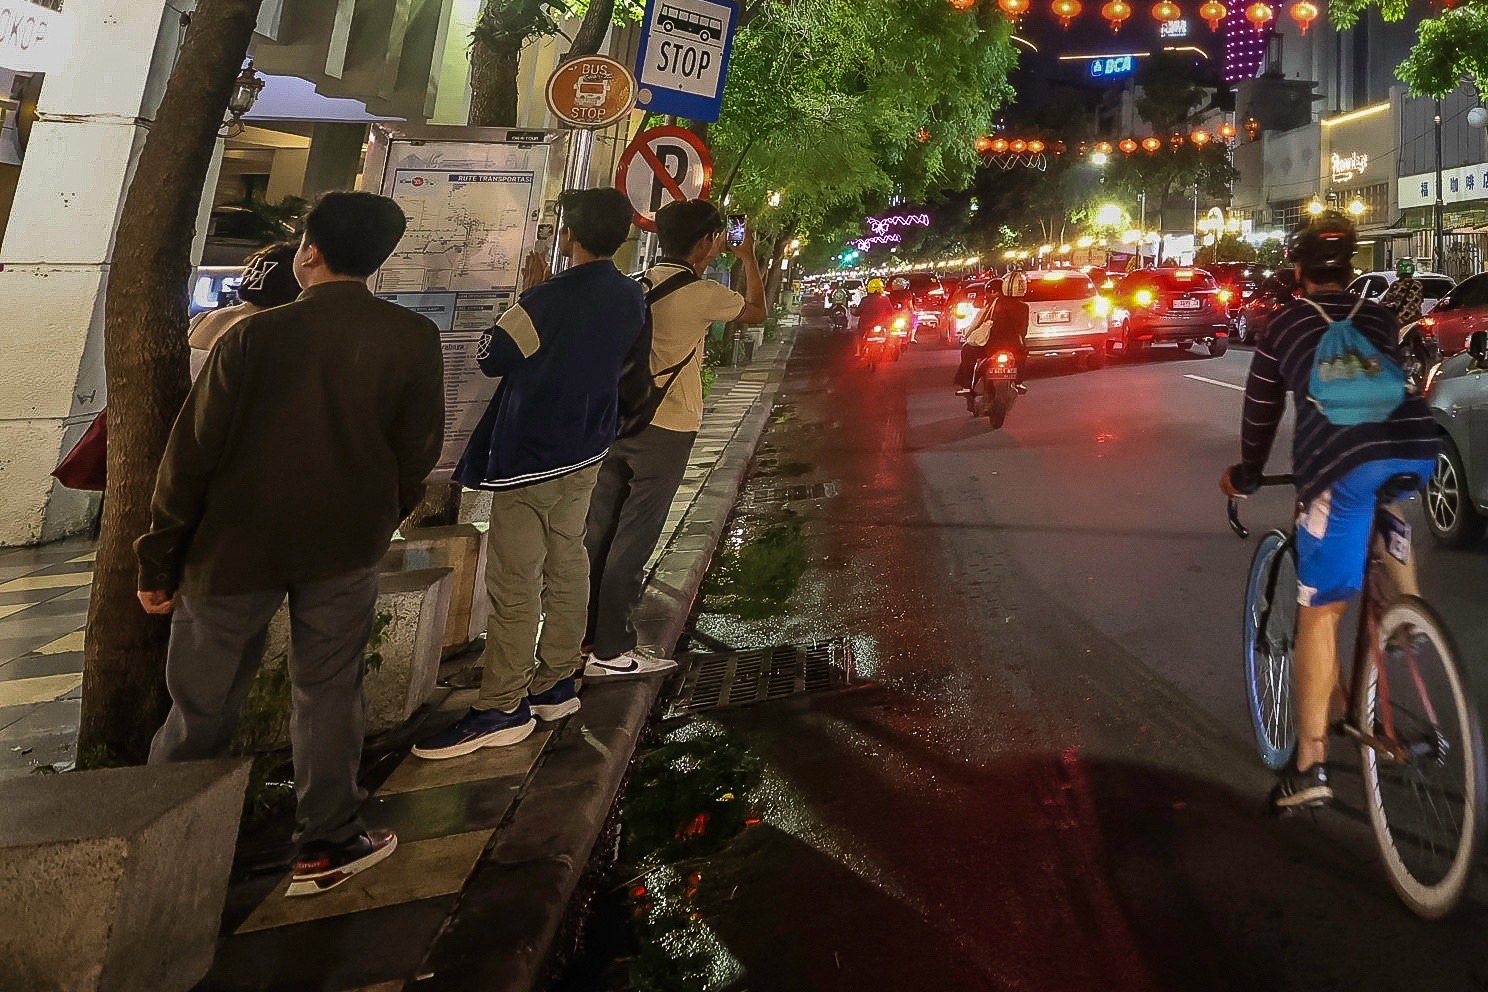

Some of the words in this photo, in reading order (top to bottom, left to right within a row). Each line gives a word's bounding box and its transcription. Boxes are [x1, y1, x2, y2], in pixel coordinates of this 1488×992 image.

[657, 41, 711, 80] STOP
[1105, 56, 1132, 74] BCA
[582, 63, 608, 75] BUS
[571, 107, 606, 119] STOP
